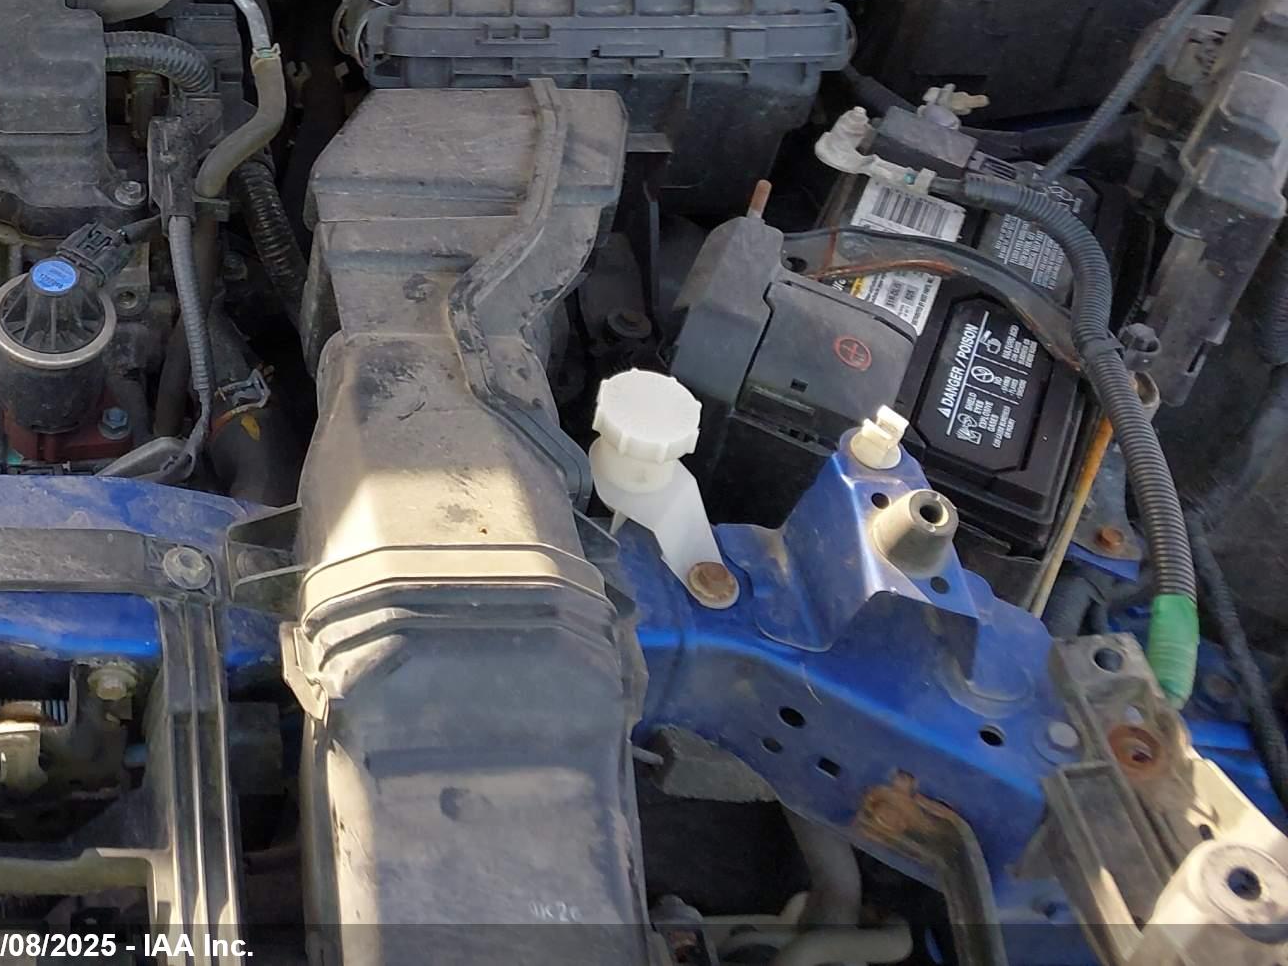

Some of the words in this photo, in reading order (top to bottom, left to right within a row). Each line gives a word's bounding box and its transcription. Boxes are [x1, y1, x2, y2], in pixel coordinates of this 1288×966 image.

[941, 365, 964, 408] DANGER
[957, 323, 977, 359] POISON
[994, 376, 1003, 386] NO
[965, 392, 977, 411] SHIELD
[973, 400, 984, 414] EYES
[978, 401, 994, 429] EXPLOSIVE
[987, 414, 999, 432] GASES
